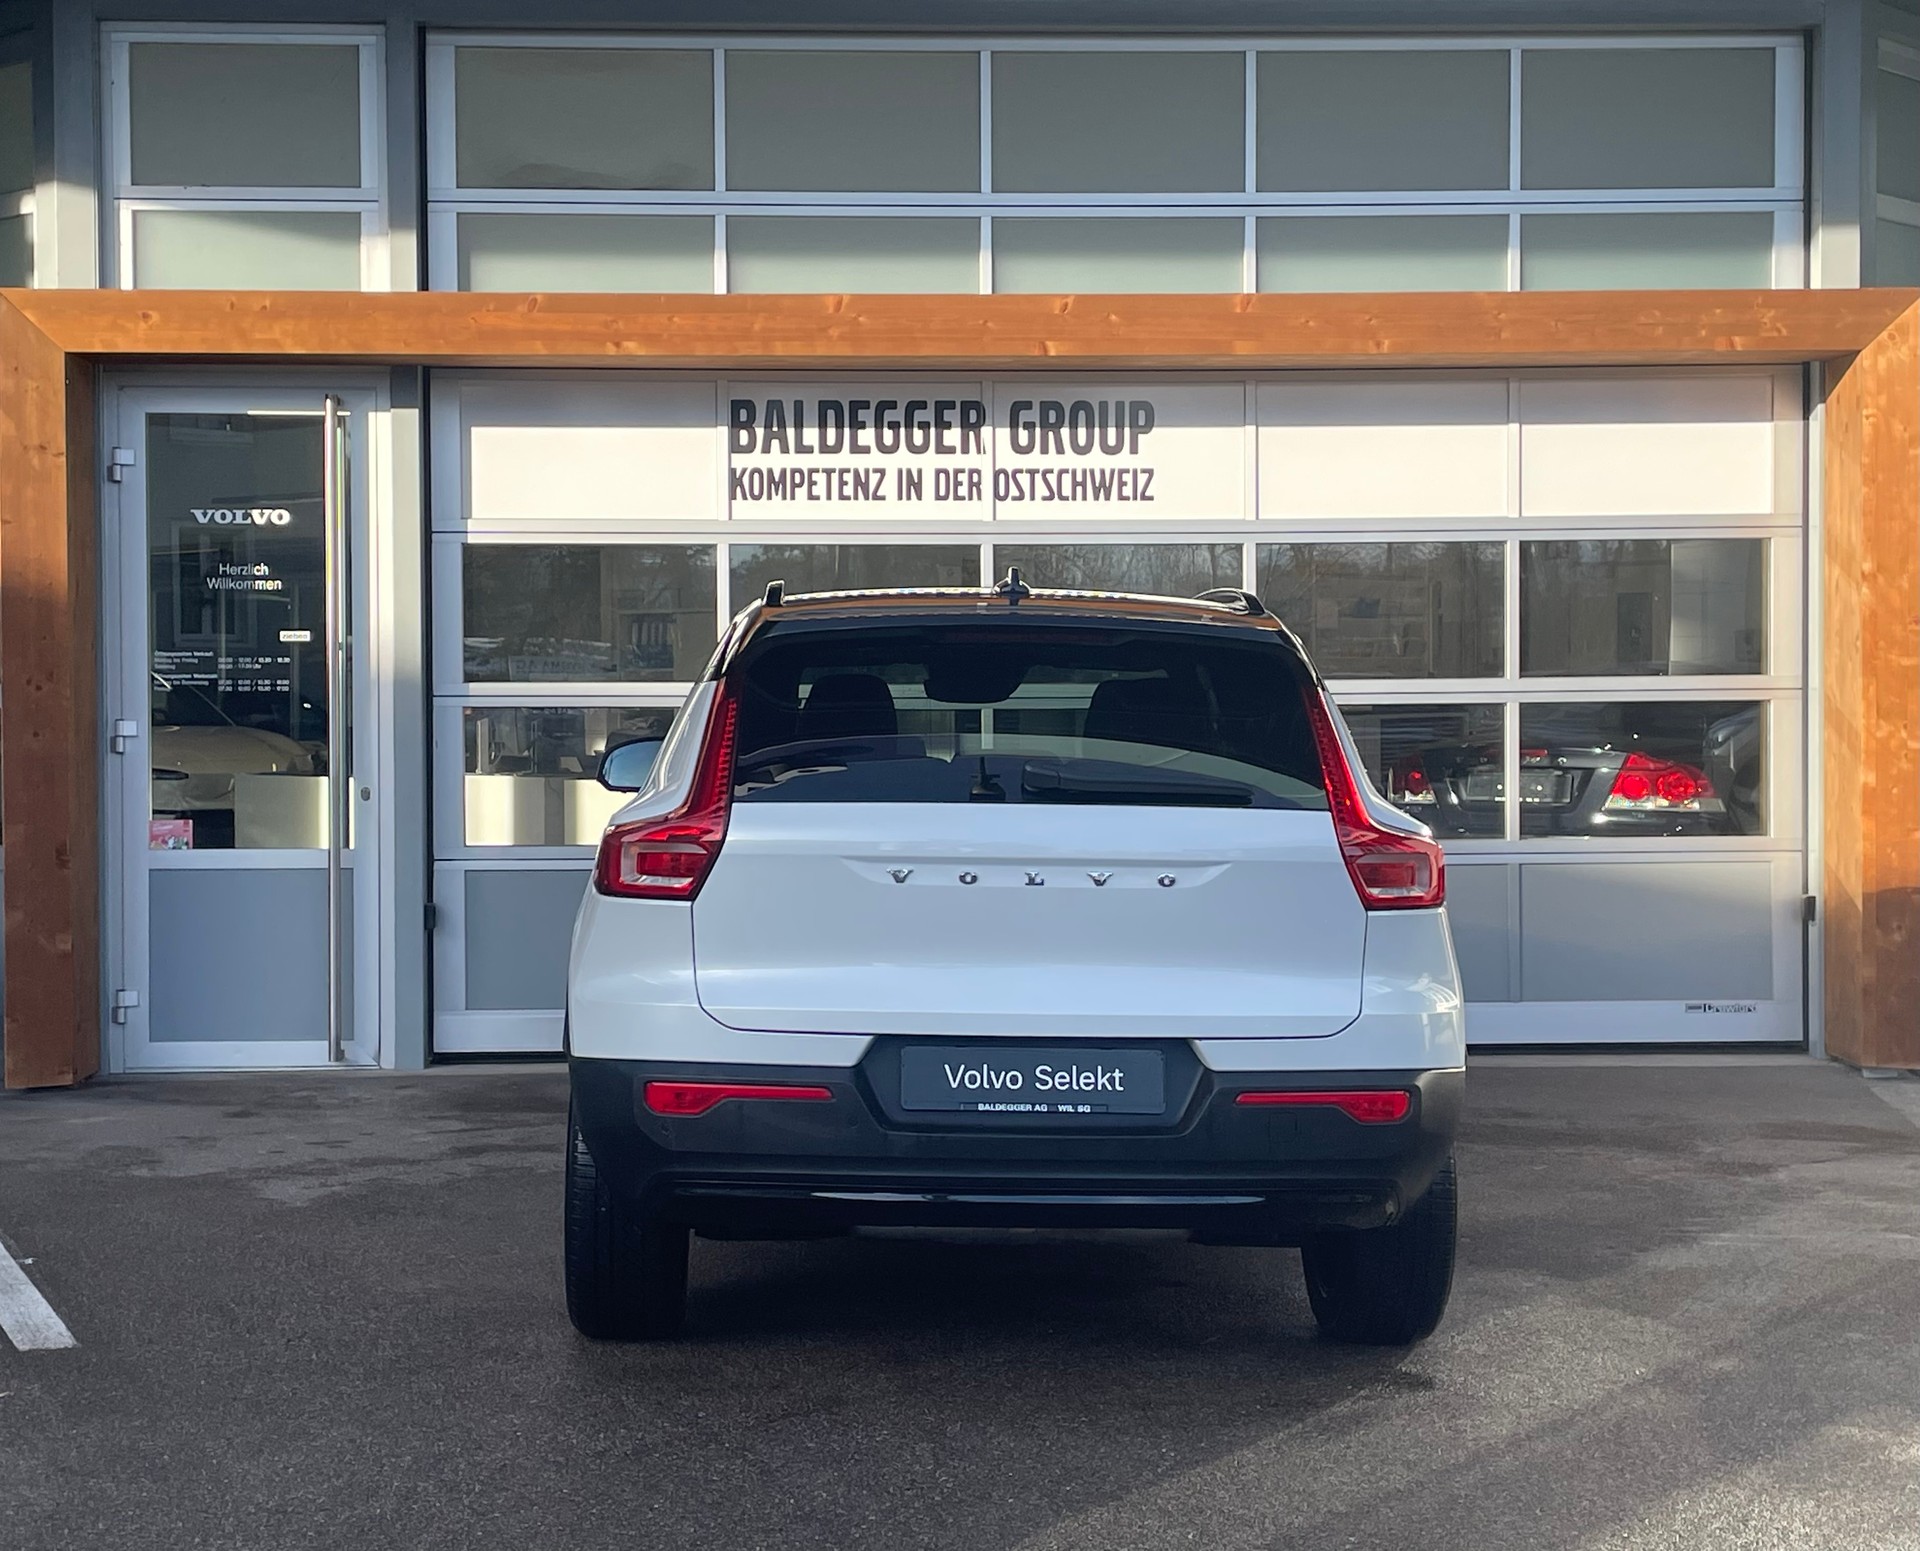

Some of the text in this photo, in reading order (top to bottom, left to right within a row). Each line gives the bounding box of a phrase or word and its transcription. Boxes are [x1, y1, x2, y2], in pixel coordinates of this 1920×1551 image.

[730, 399, 1156, 456] BALDEGGER GROUP
[730, 467, 1155, 501] KOMPETENZ IN DER OSTSCHWEIZ
[190, 508, 291, 525] VOLVO
[218, 563, 269, 576] Herzlich
[206, 577, 283, 591] Willkommen
[886, 868, 1177, 888] VOLVO
[944, 1064, 1125, 1091] Volvo Selekt
[978, 1103, 1091, 1113] BALDEGGER AG WIL SG
